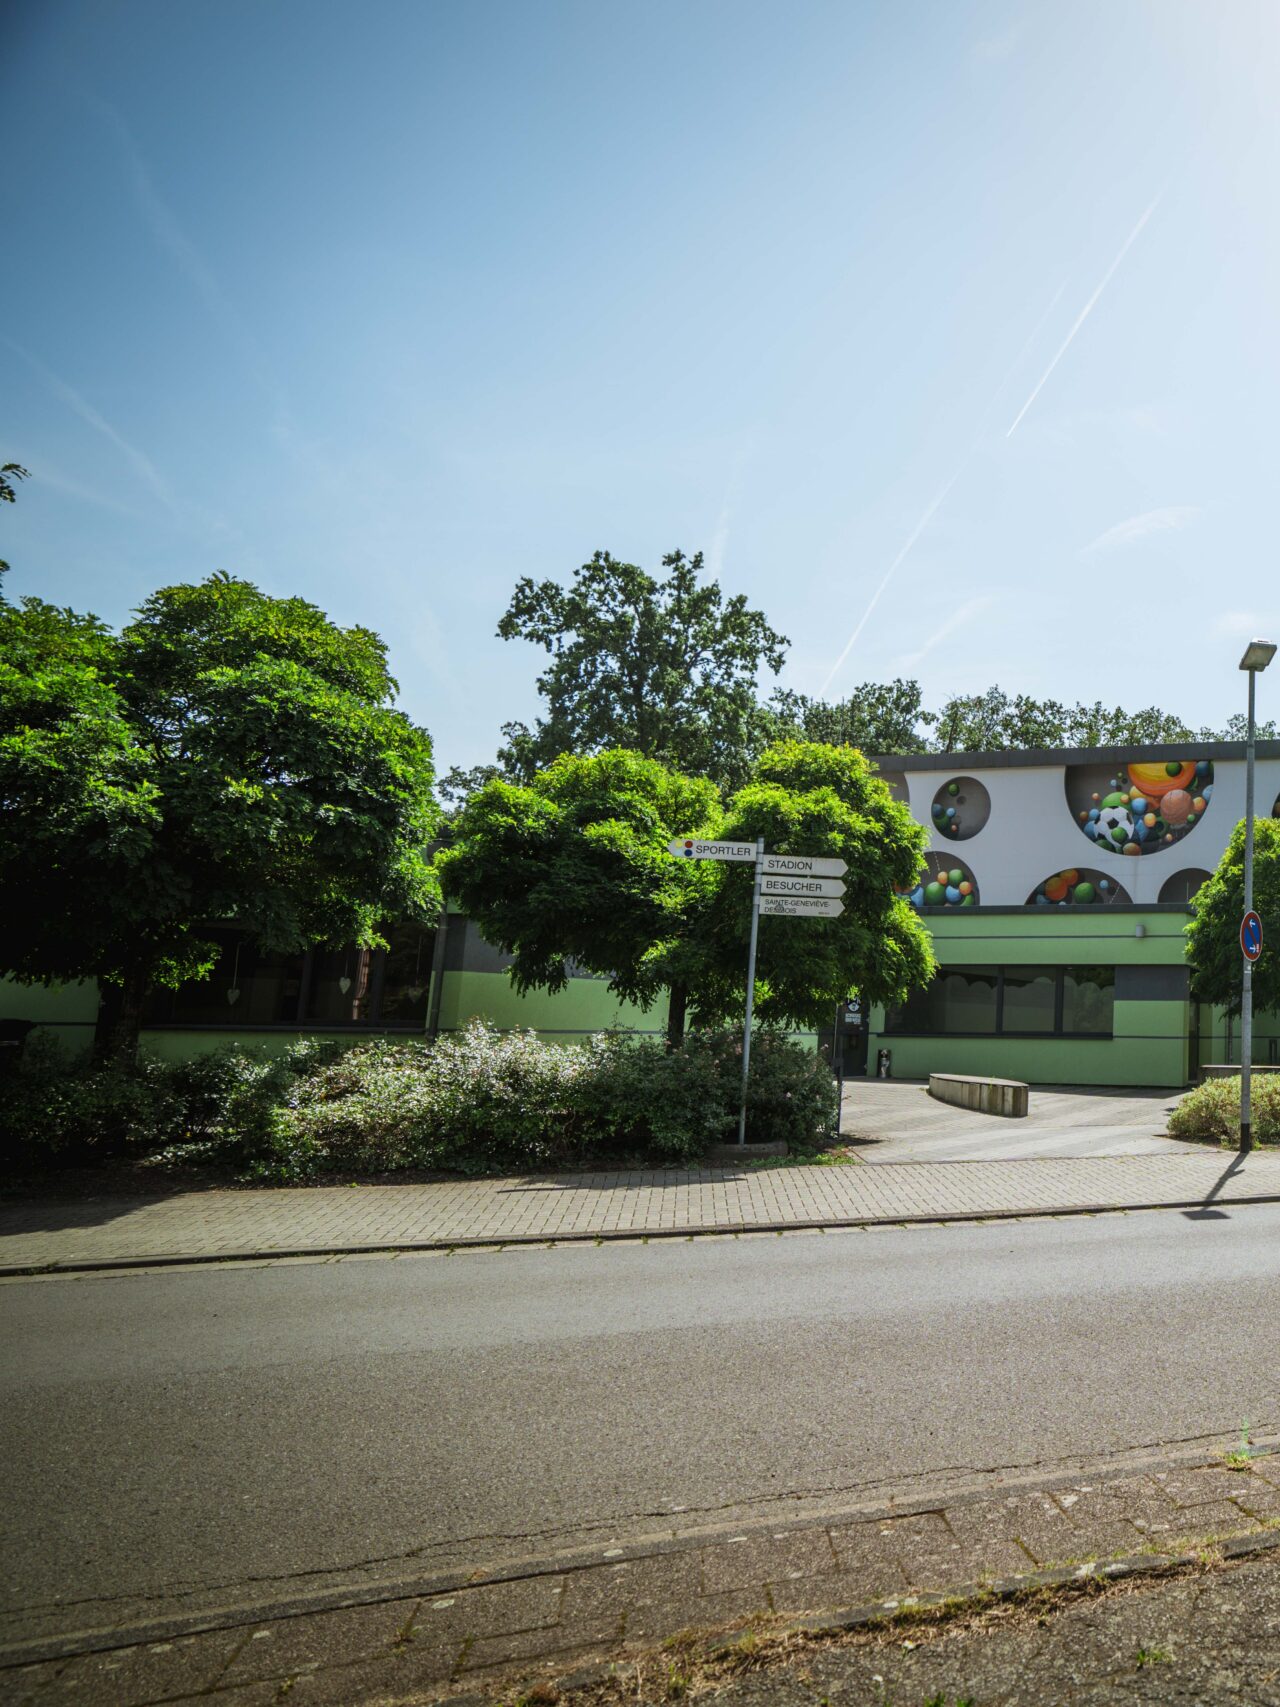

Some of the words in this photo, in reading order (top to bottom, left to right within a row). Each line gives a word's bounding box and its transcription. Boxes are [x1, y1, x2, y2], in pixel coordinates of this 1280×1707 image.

[695, 844, 751, 857] SPORTLER
[767, 859, 813, 871] STADION
[765, 880, 822, 893] BESUCHER
